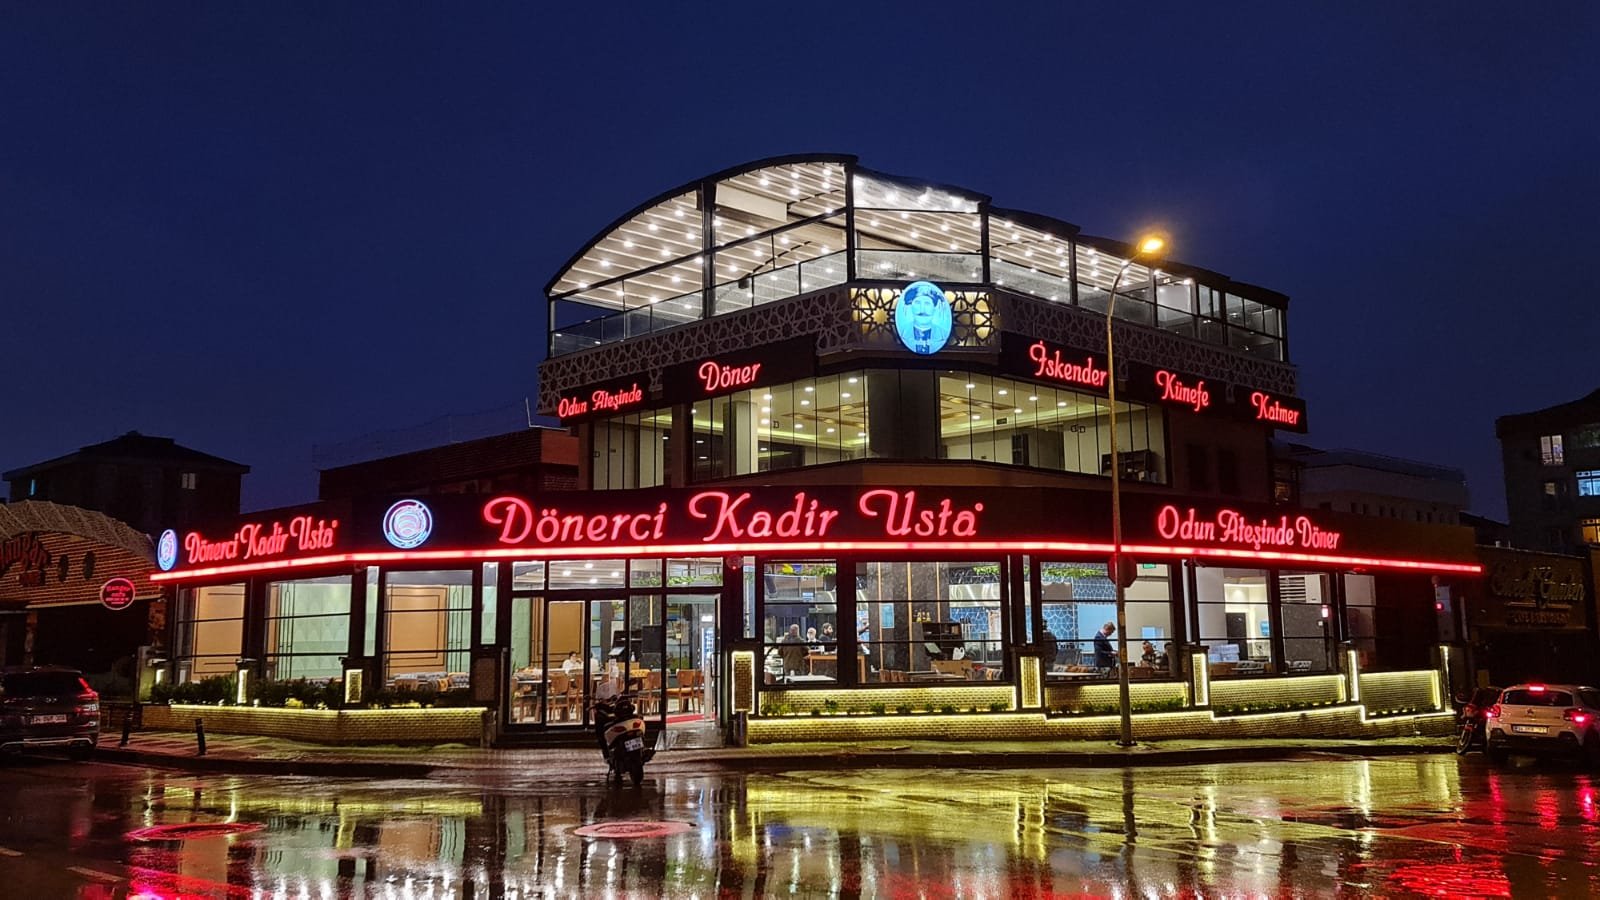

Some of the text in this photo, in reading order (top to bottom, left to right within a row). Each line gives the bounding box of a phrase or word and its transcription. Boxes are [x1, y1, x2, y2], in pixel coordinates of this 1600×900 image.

[698, 361, 761, 392] Döner
[1029, 340, 1108, 387] İskender
[558, 383, 643, 418] Odun Ateşinde
[1155, 369, 1209, 412] Künefe
[1251, 392, 1299, 425] Katmer
[483, 489, 985, 545] Dönerci Kadir Usta
[1157, 504, 1341, 550] Odun Ateşinde Döner
[184, 516, 338, 564] Dönerci Kadir Usta
